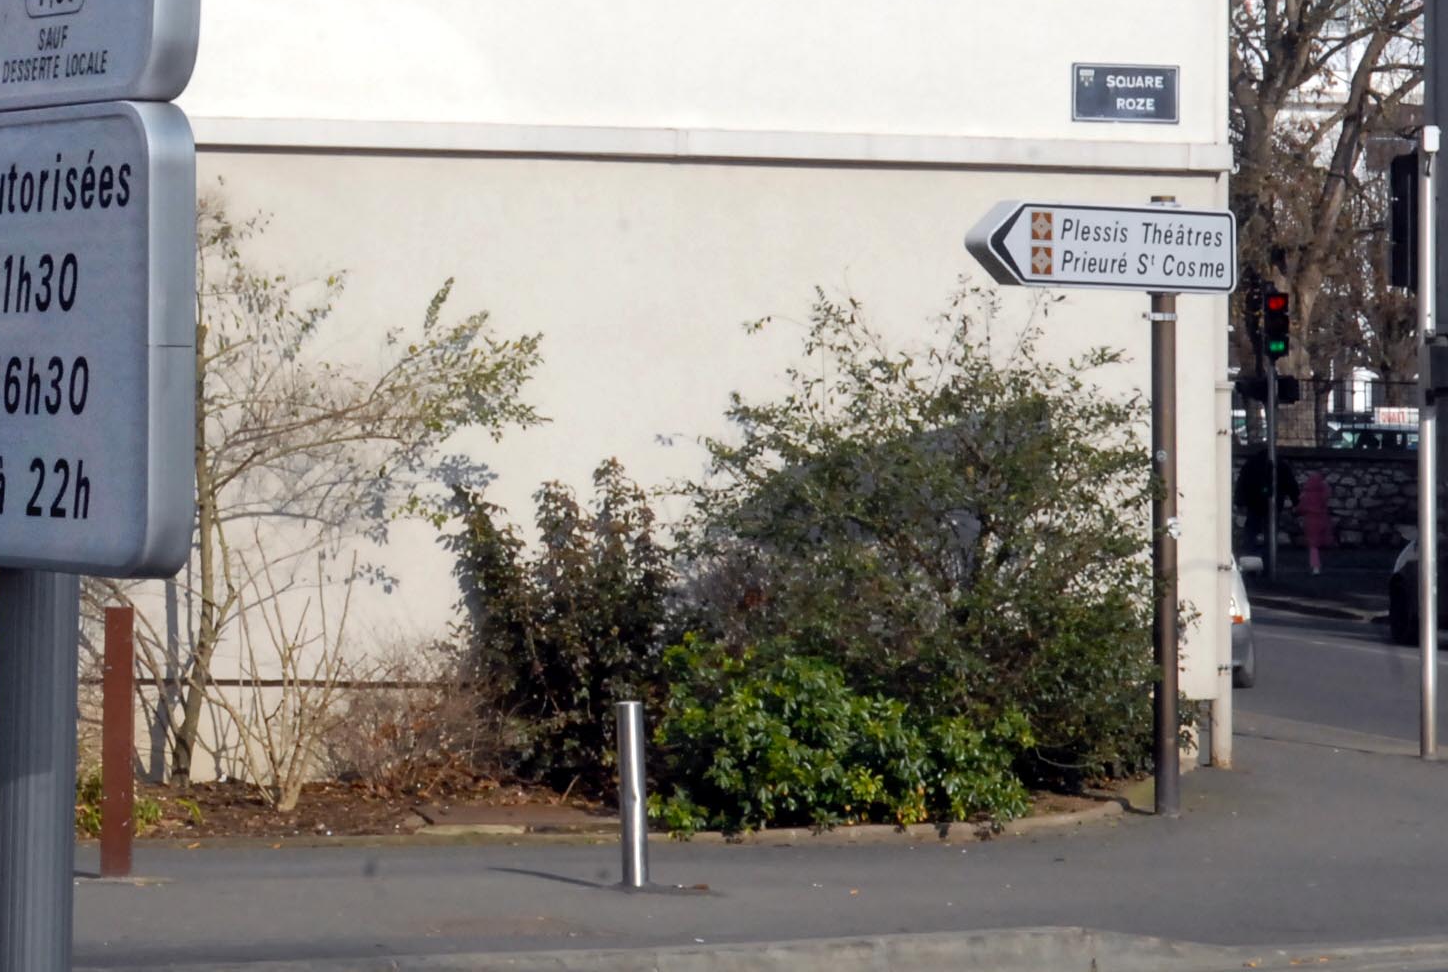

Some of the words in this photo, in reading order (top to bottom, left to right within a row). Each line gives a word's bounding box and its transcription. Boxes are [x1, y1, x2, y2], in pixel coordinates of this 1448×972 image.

[37, 25, 69, 51] SAUF
[2, 55, 61, 84] DESSERTE
[65, 50, 108, 77] LOCALE
[1106, 75, 1164, 89] SQUARE
[1116, 98, 1156, 111] ROZE
[1061, 218, 1129, 244] Plessis
[1142, 222, 1223, 247] Théâtres
[1061, 250, 1128, 275] Prieuré
[1137, 253, 1155, 275] St
[1162, 254, 1225, 278] Cosme
[25, 458, 92, 519] 22h
